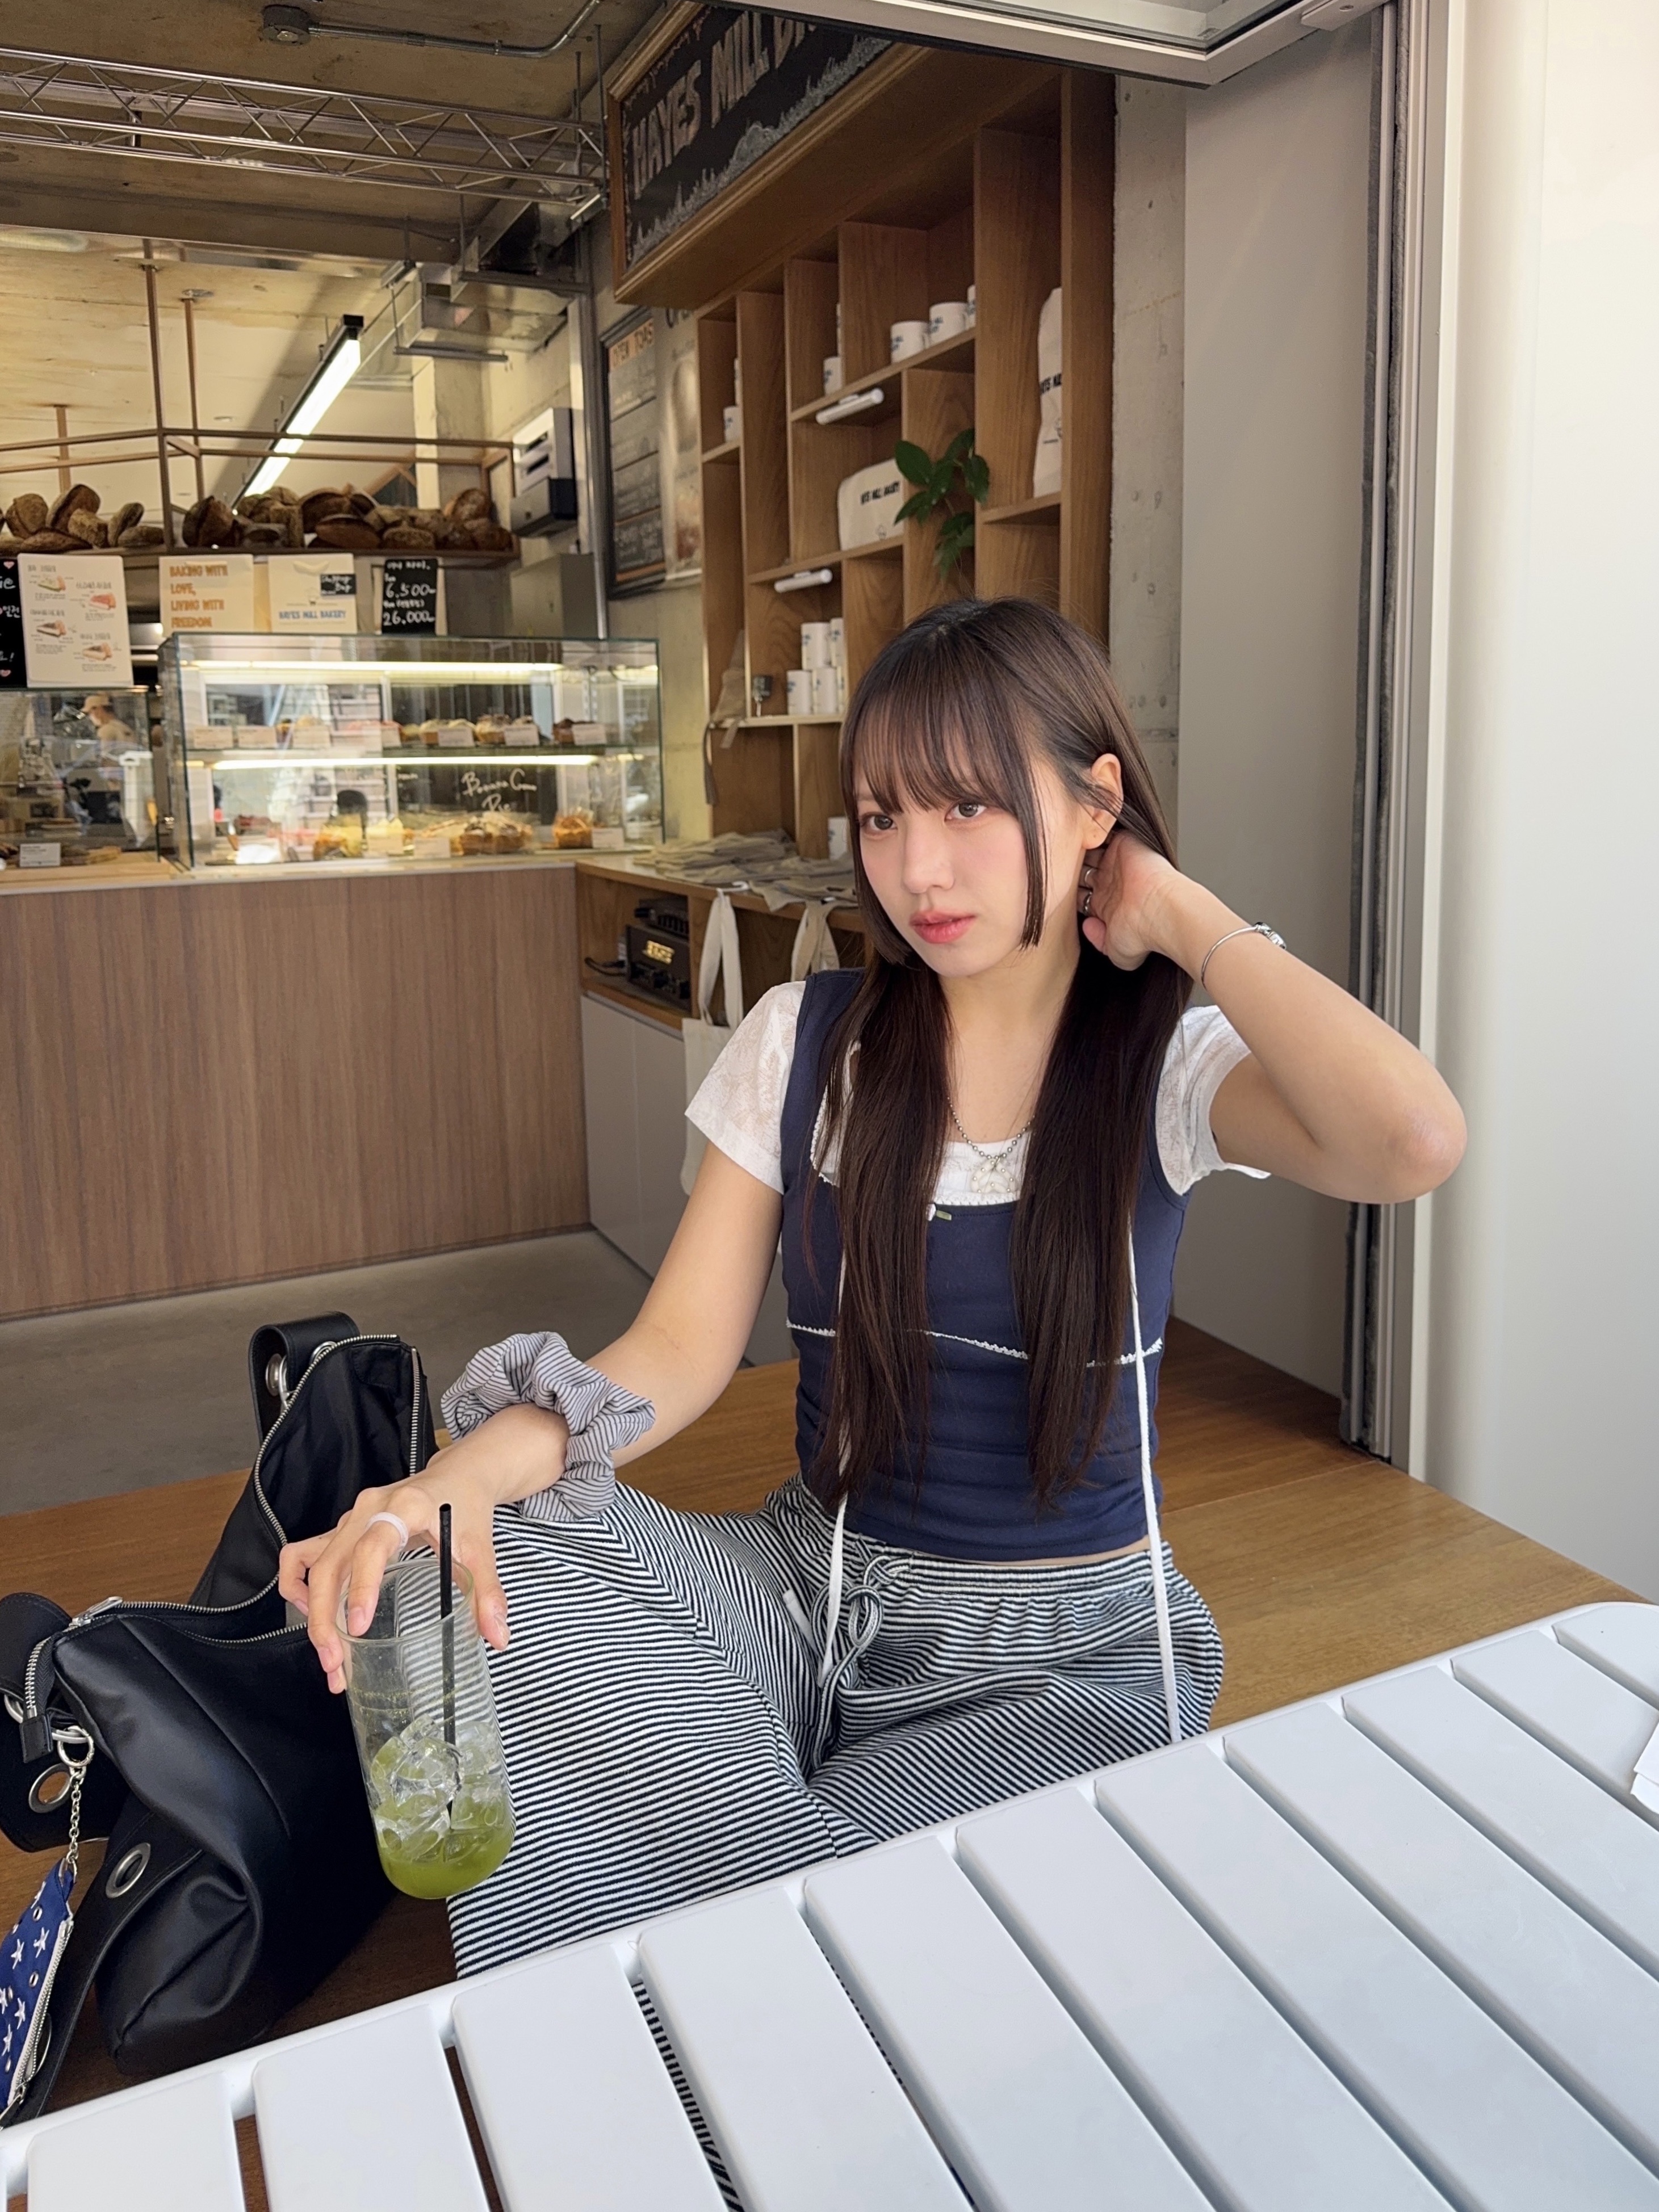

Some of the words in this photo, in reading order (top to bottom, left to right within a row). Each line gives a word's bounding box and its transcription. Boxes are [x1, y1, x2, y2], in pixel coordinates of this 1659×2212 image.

[632, 59, 701, 200] HAYES
[170, 565, 203, 576] BAKING
[205, 565, 228, 576] WITH
[171, 583, 196, 595] LOVE,
[171, 601, 199, 611] LIVING
[203, 599, 225, 610] WITH
